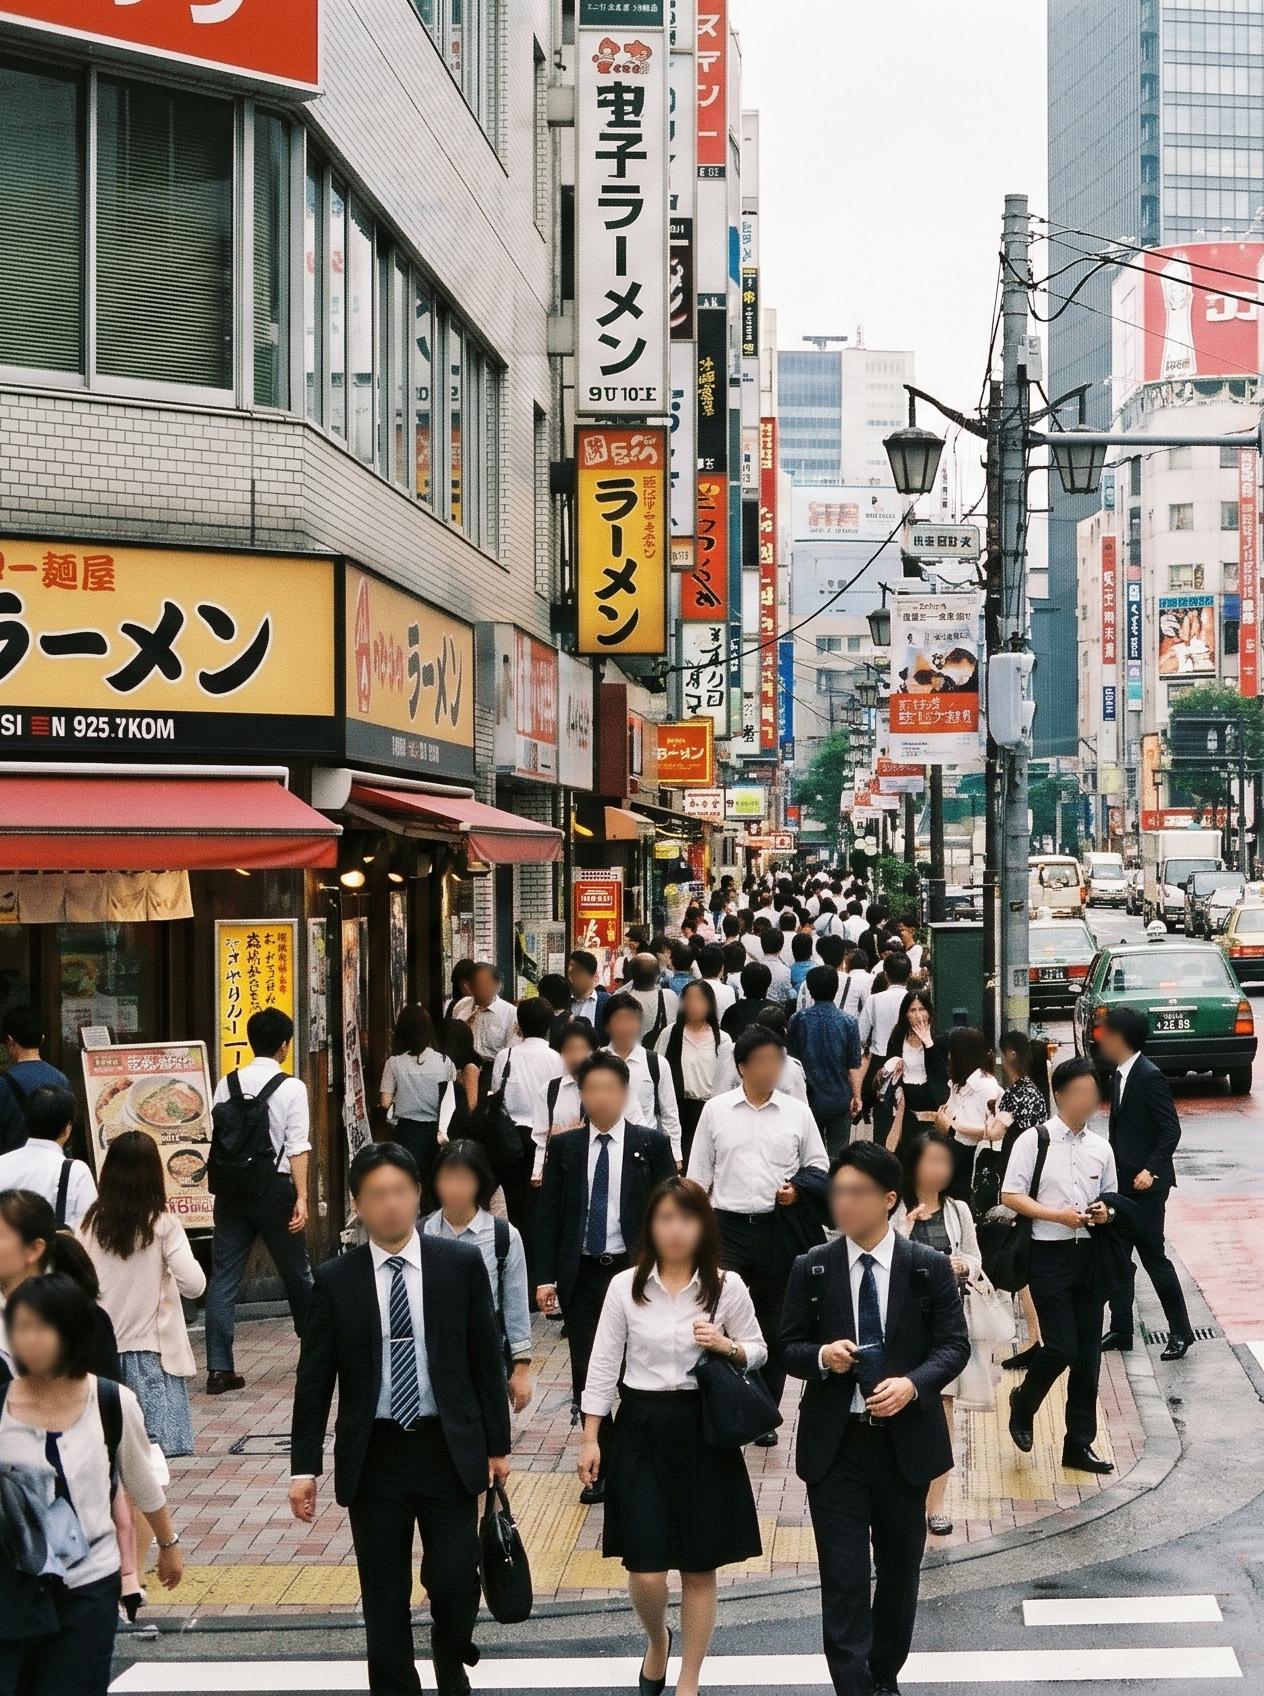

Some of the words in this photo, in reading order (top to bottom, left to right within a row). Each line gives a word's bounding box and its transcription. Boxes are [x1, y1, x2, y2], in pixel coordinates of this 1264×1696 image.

[594, 477, 639, 646] ラーメン
[408, 623, 462, 728] ラーメン
